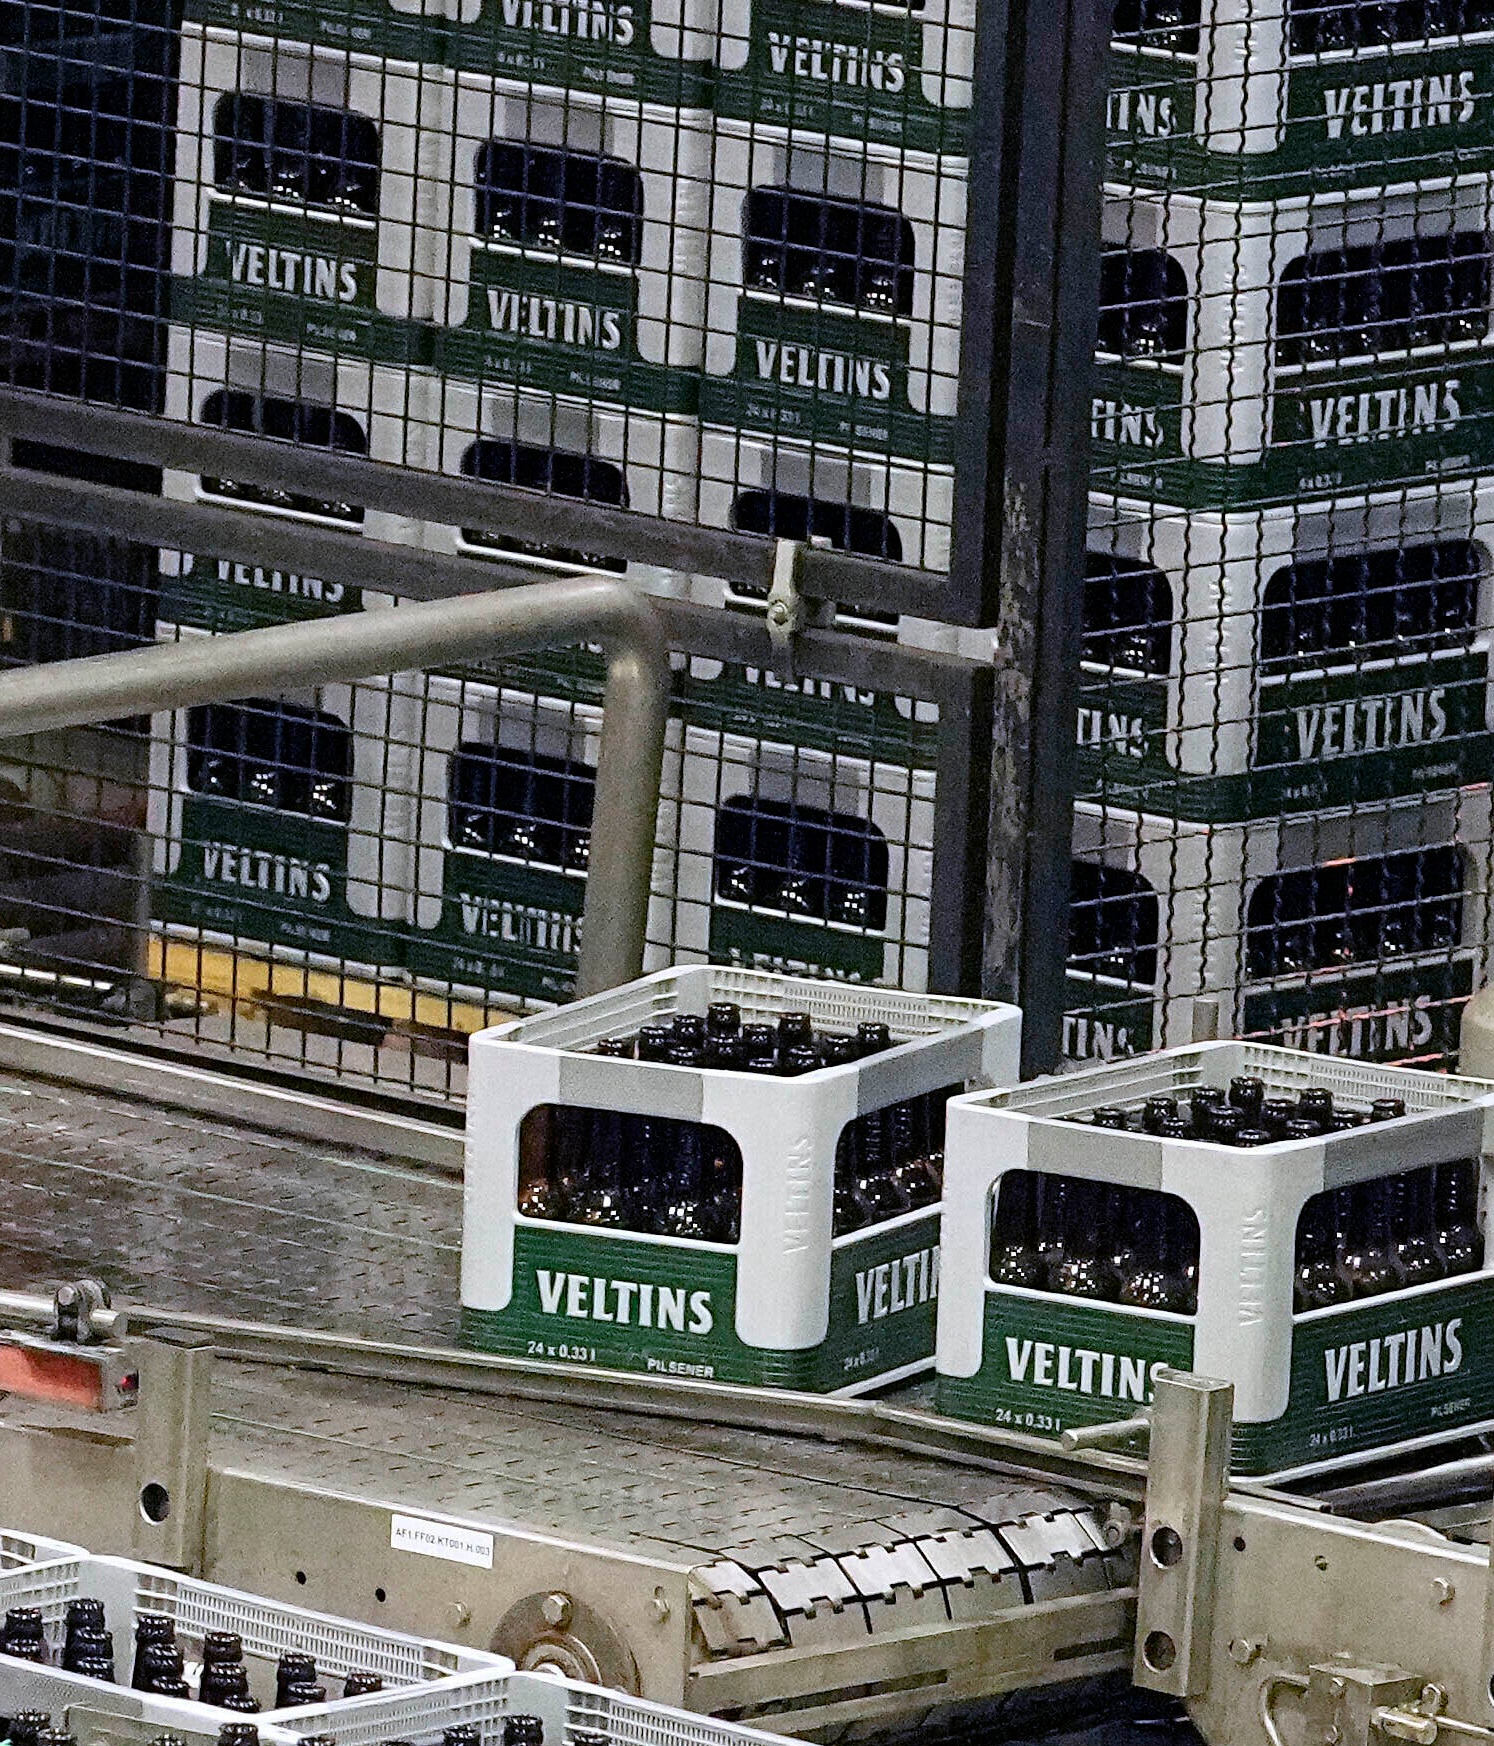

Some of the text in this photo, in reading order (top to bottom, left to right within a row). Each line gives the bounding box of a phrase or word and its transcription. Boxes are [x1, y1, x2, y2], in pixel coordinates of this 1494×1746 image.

[768, 31, 905, 94] VELTINS
[1324, 70, 1476, 139] VELTINS
[225, 240, 358, 303] VELTINS
[487, 289, 623, 351] VELTINS
[755, 339, 891, 401] VELTINS
[1308, 379, 1462, 450] VELTINS
[1295, 688, 1448, 760] VELTINS
[202, 839, 332, 904] VELTINS
[535, 1269, 715, 1336] VELTINS
[527, 1340, 545, 1355] 24
[546, 1346, 556, 1357] x
[559, 1343, 588, 1362] 0.33
[646, 1357, 716, 1379] PILSENER
[1324, 1317, 1464, 1402] VELTINS
[995, 1407, 1012, 1423] 24
[1013, 1415, 1023, 1425] x
[1025, 1412, 1054, 1431] 0.33
